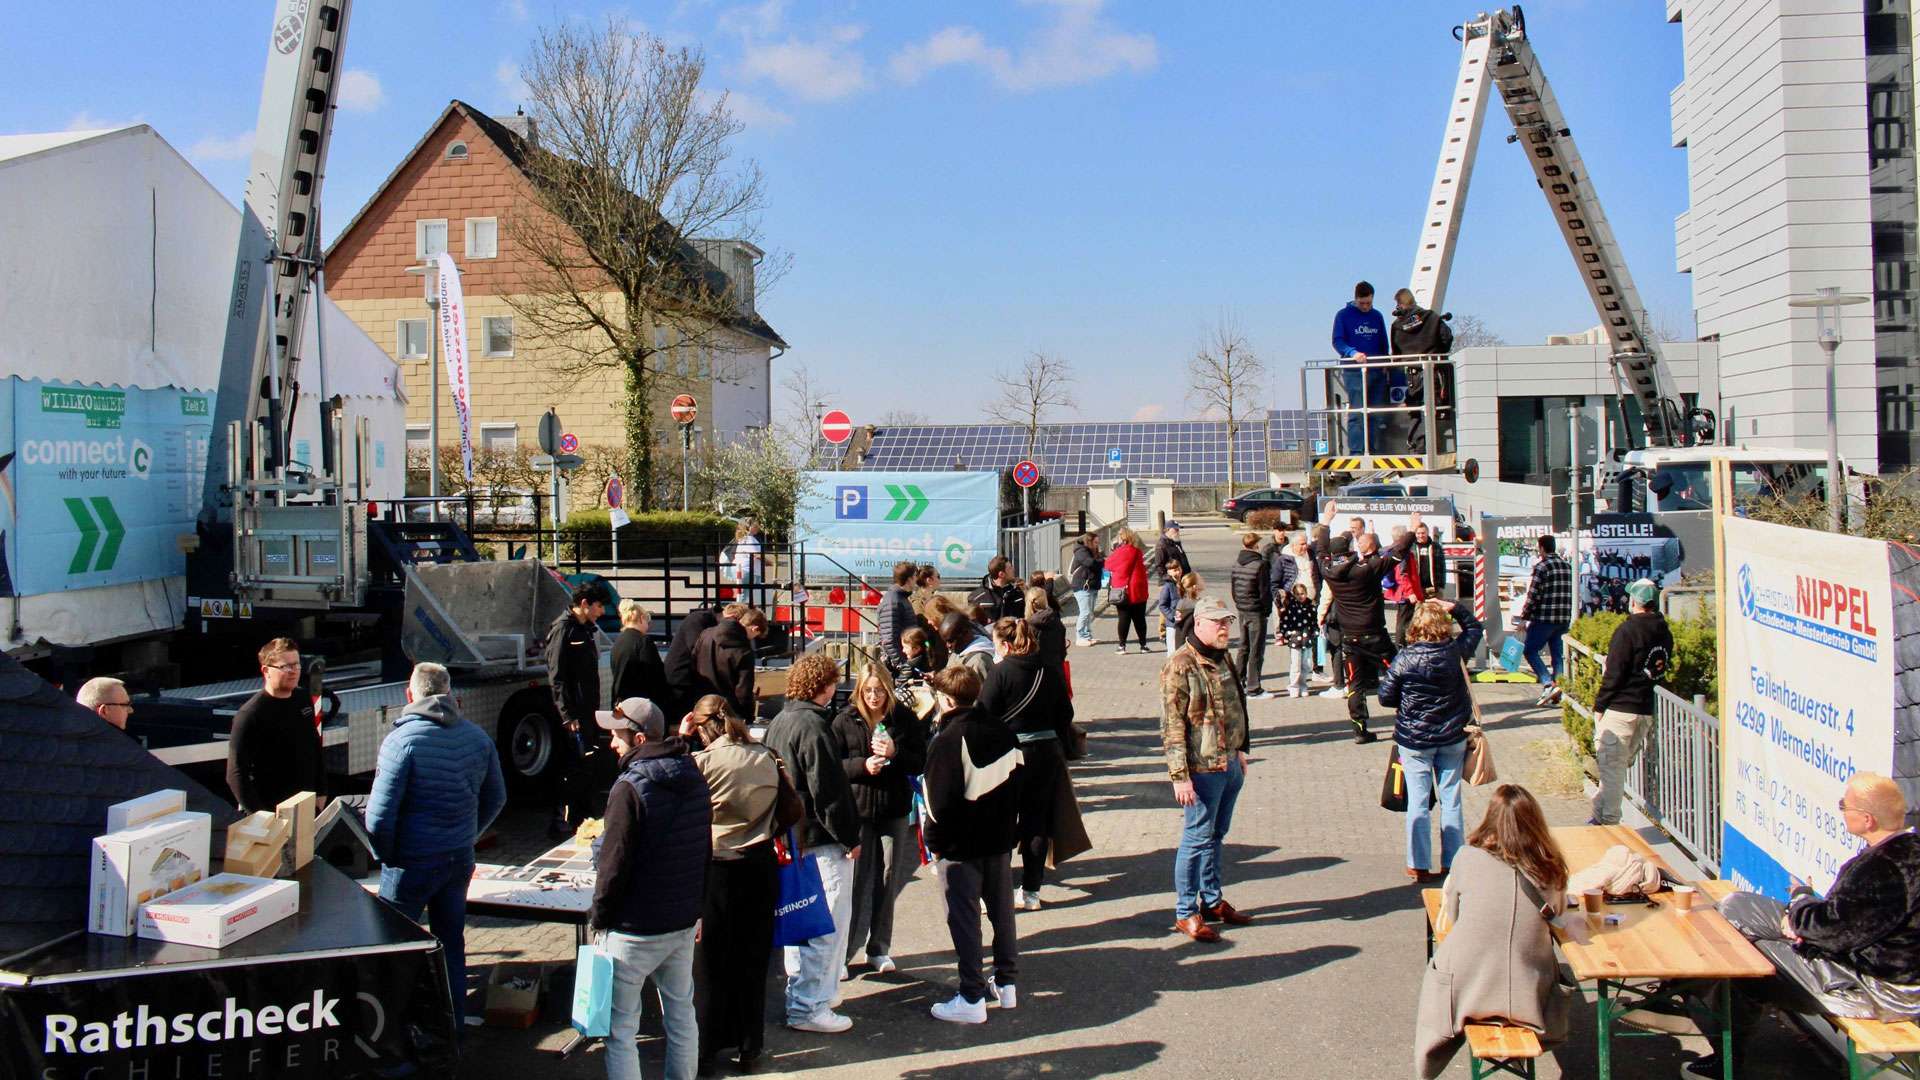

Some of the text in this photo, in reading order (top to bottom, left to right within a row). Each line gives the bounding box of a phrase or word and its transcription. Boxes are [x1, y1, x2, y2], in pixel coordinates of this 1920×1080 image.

[42, 392, 125, 412] WILLKOMMEN
[200, 400, 206, 412] 2
[22, 435, 127, 465] connect
[59, 467, 127, 482] with your future
[842, 489, 861, 516] P
[1394, 503, 1407, 512] VON
[816, 532, 935, 556] connect
[855, 558, 876, 568] with
[1756, 575, 1877, 636] CHRISTIAN NIPPEL
[1755, 606, 1878, 660] Dachdecker-Meisterbetrieb GmbH
[1750, 666, 1855, 737] Feilenhauerstr. 4
[1771, 715, 1857, 784] Wermelskirch
[1795, 793, 1808, 819] 96
[1815, 807, 1823, 829] 8
[1825, 812, 1837, 839] 89
[1794, 831, 1806, 857] 91
[778, 898, 809, 917] STEINCO
[44, 988, 341, 1054] Rathscheck
